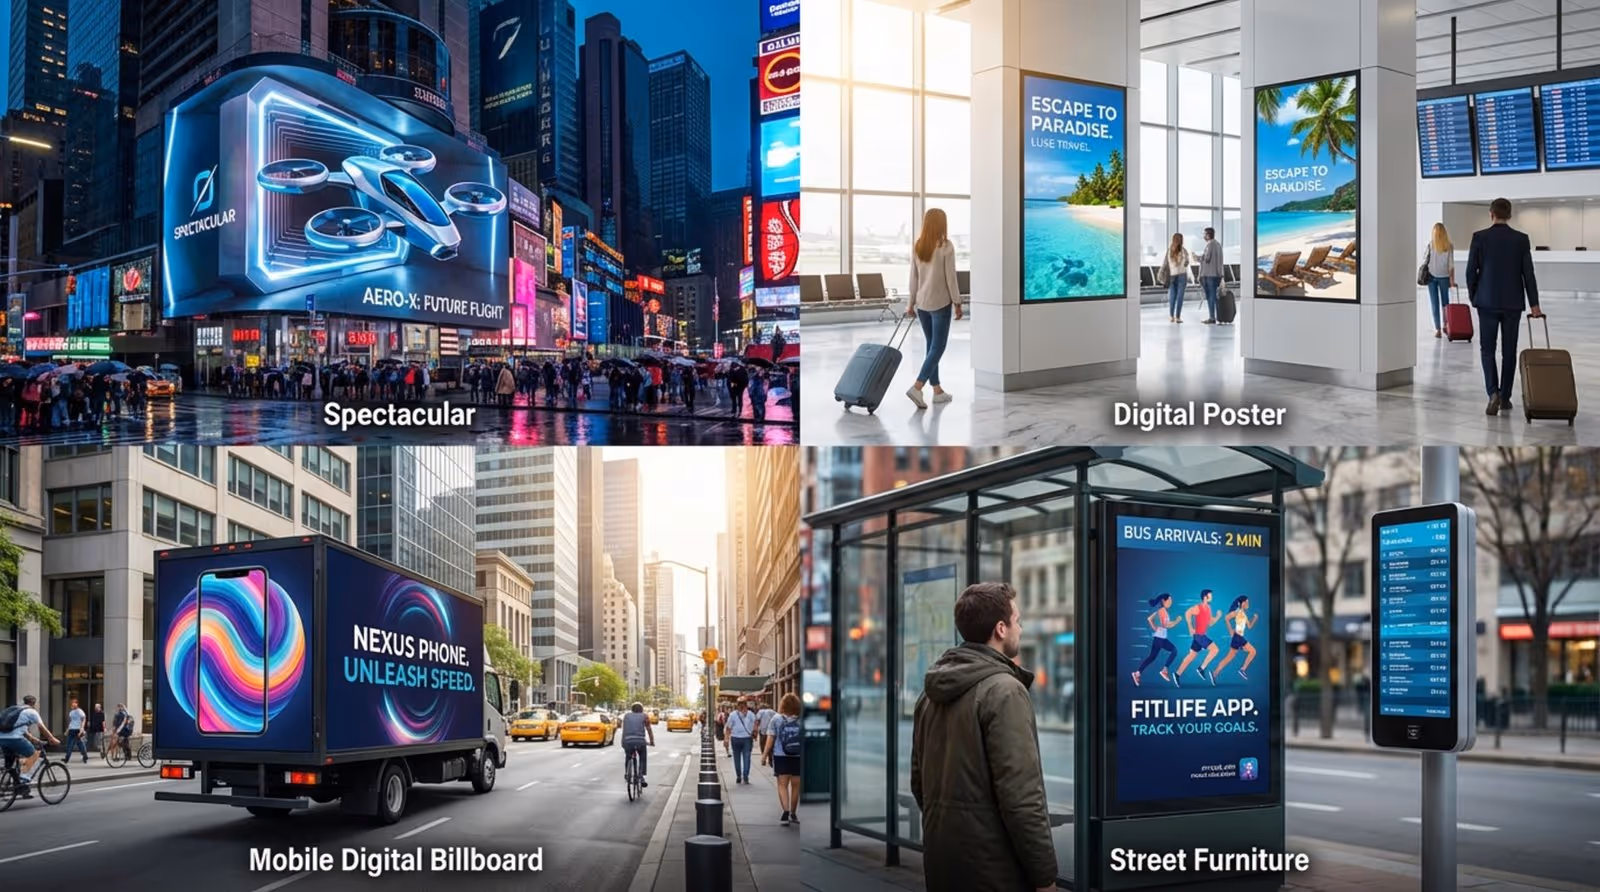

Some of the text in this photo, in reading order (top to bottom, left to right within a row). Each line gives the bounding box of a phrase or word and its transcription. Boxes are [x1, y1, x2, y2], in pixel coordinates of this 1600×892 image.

[1031, 96, 1117, 121] ESCAPE TO
[1031, 115, 1113, 140] PARADISE.
[1265, 165, 1328, 180] ESCAPE TO
[362, 287, 504, 319] AERO-X: FUTURE FLIGHT
[1124, 525, 1262, 548] BUS ARRIVALS: 2 MIN
[353, 624, 470, 667] NEXUS PHONE.
[344, 656, 476, 692] UNLEASH SPEED.
[1131, 698, 1259, 719] FITLIFE APP.
[1131, 721, 1259, 736] TRACK YOUR GOALS.
